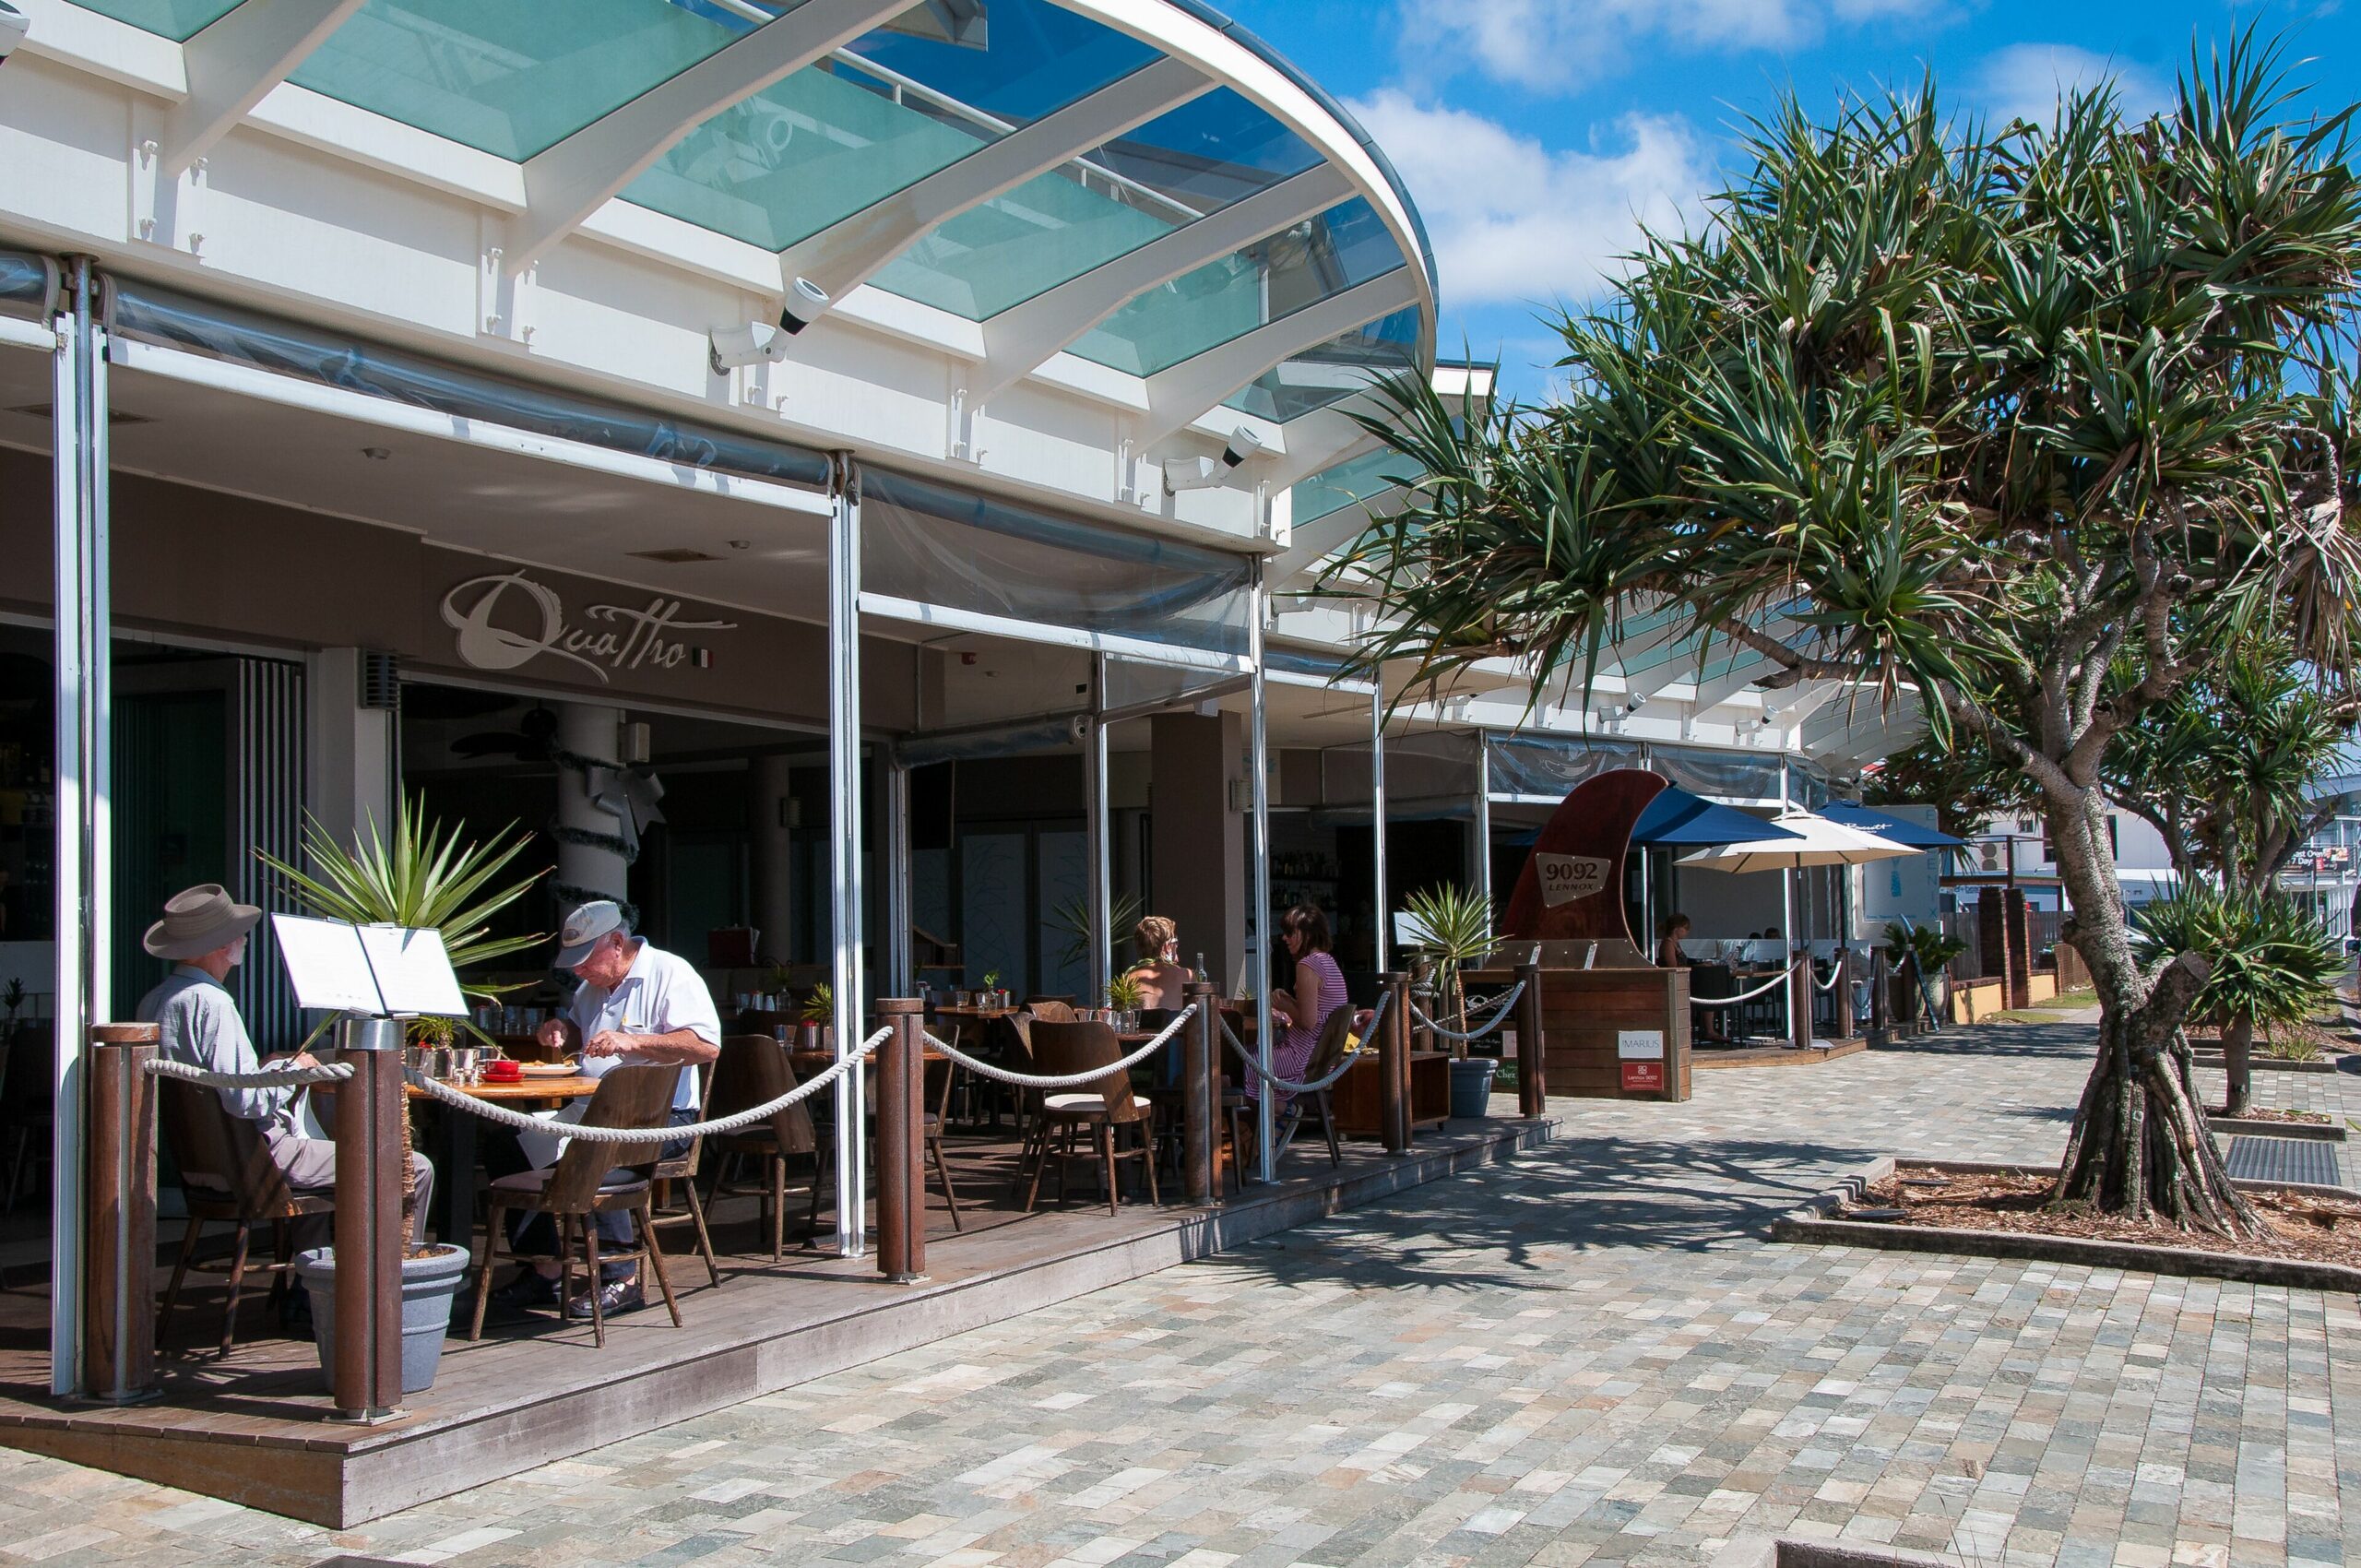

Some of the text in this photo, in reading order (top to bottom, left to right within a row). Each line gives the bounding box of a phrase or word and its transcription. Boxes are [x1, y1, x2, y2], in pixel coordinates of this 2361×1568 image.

[440, 568, 738, 684] Quattro
[1546, 861, 1598, 881] 9092
[1548, 883, 1594, 892] LENNOX
[1496, 1068, 1516, 1079] Chez
